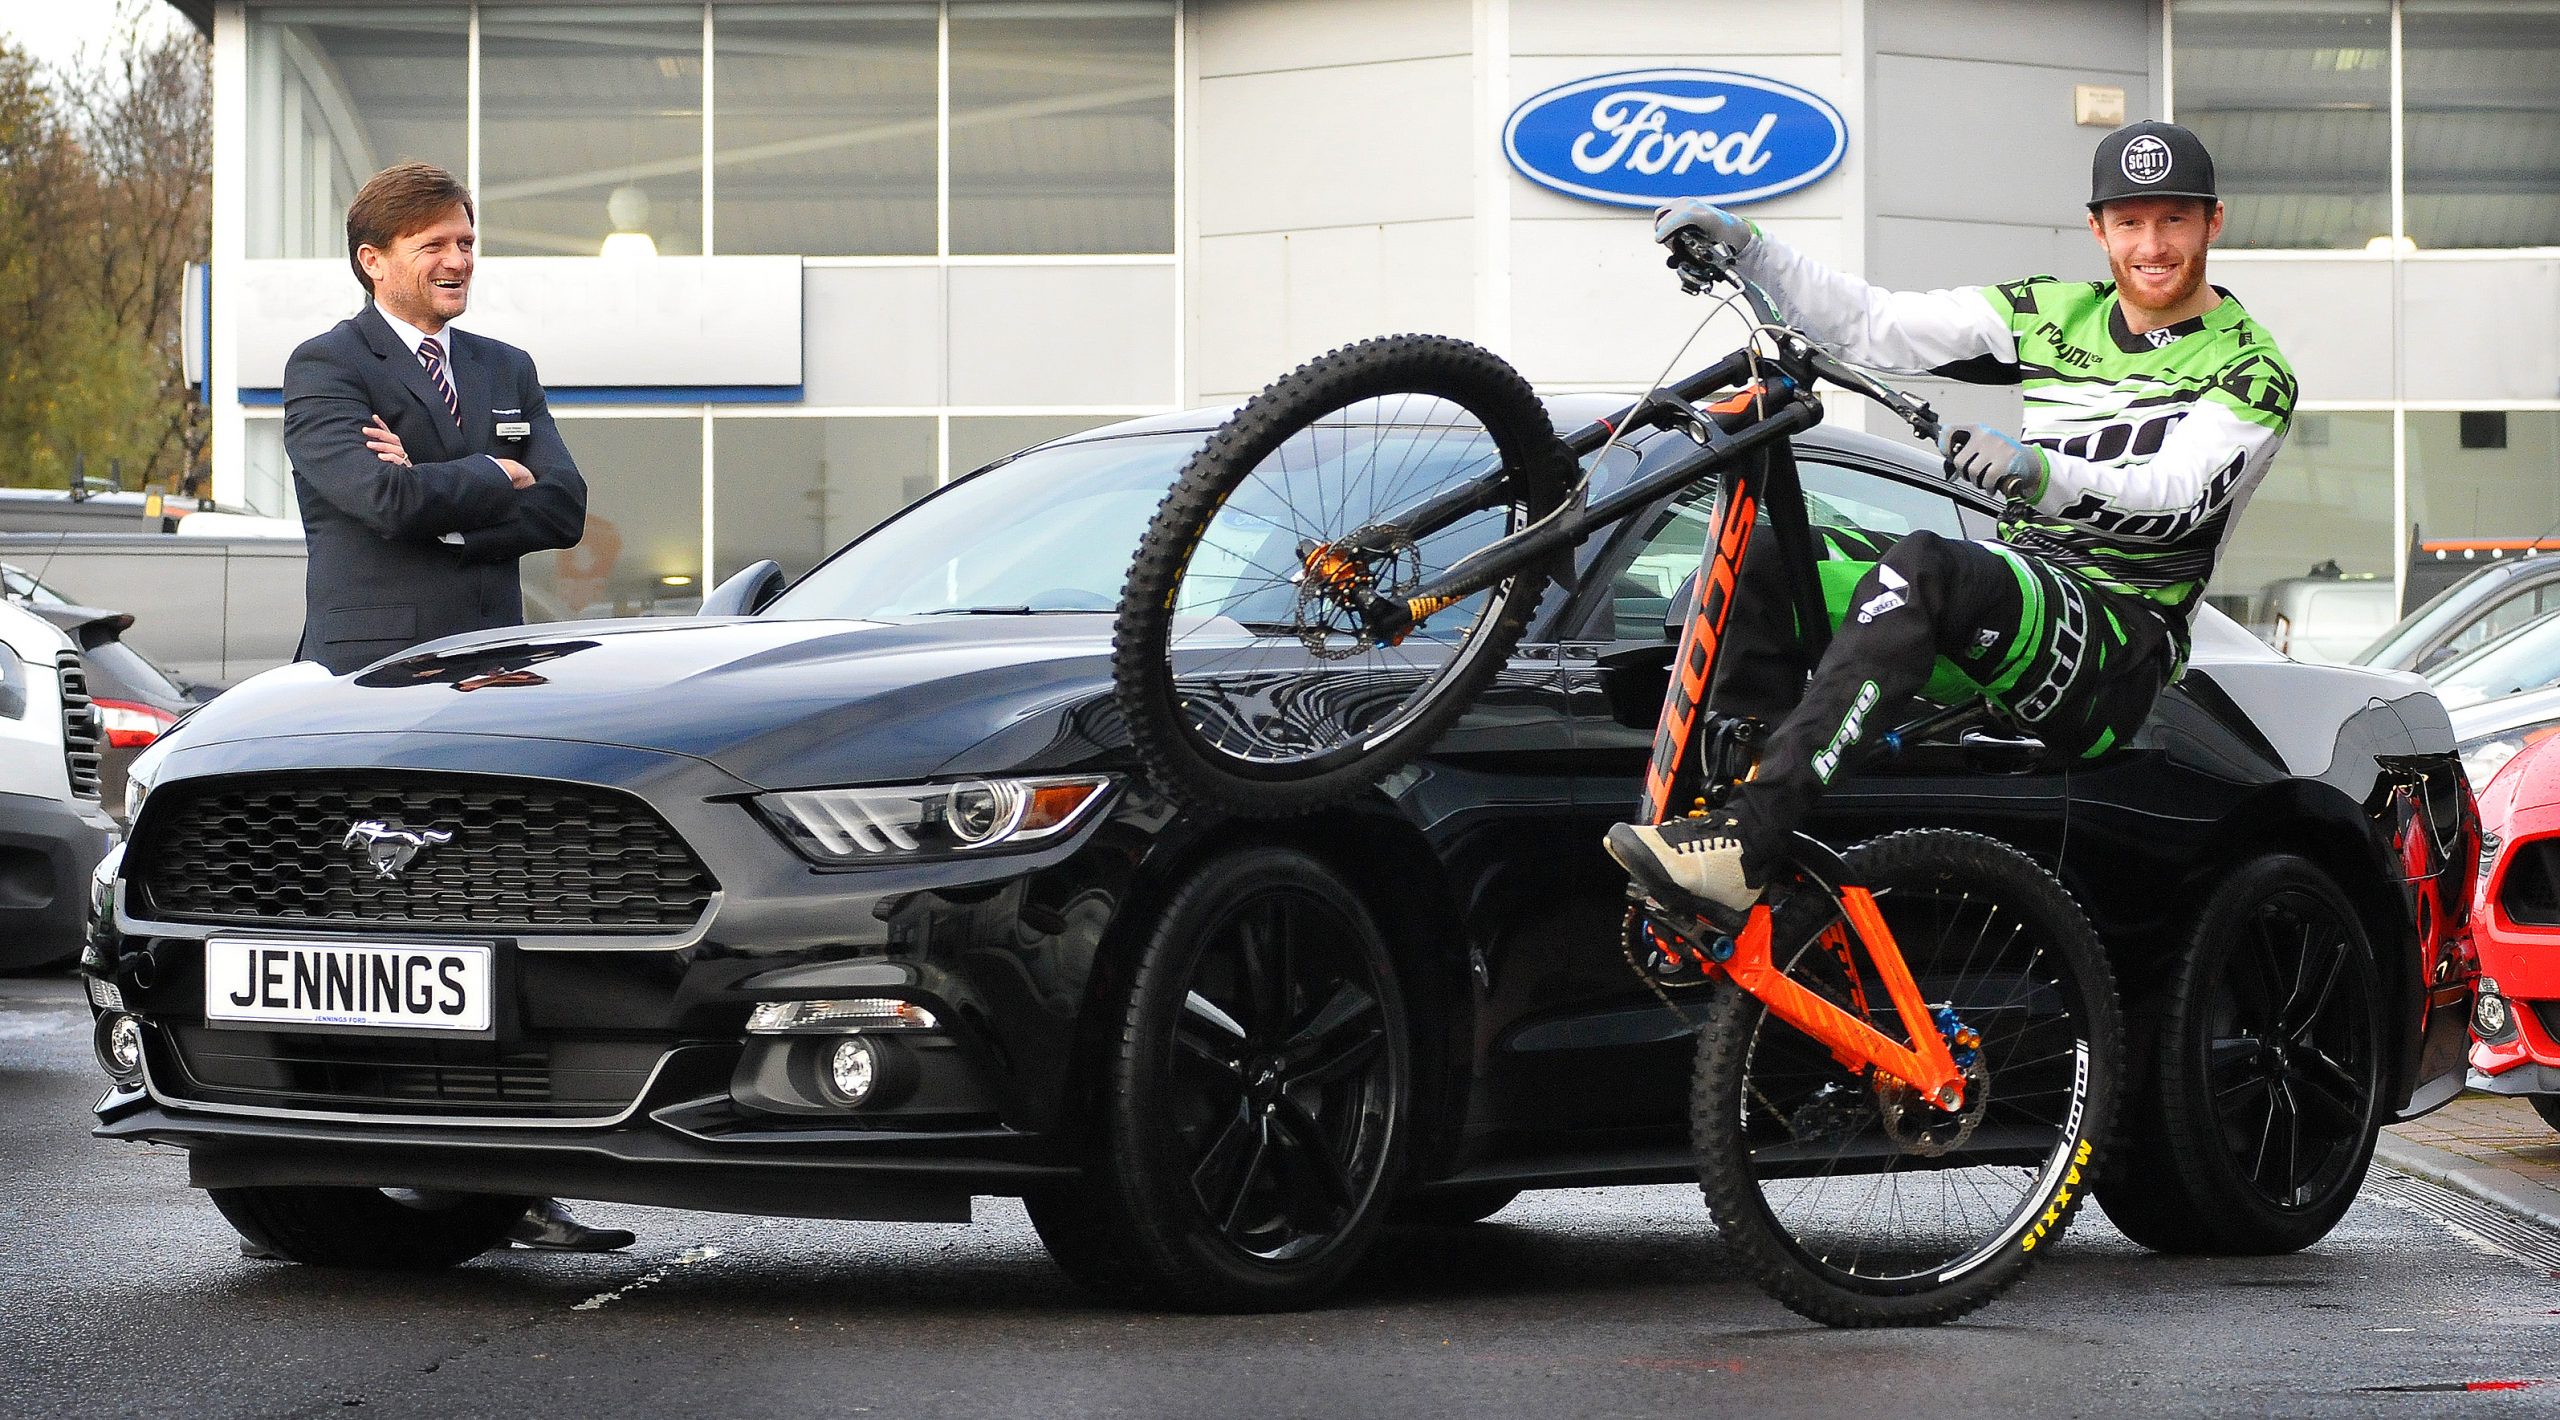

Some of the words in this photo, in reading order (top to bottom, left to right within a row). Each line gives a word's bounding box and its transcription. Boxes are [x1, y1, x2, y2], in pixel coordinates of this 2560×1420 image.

[1571, 91, 1777, 175] Ford
[2128, 152, 2164, 170] SCOTT
[1646, 477, 1756, 826] SCOTT
[2014, 568, 2088, 722] ope
[230, 949, 466, 1015] JENNINGS
[314, 1015, 347, 1023] JENNINGS
[2021, 1138, 2093, 1252] MAXXIS
